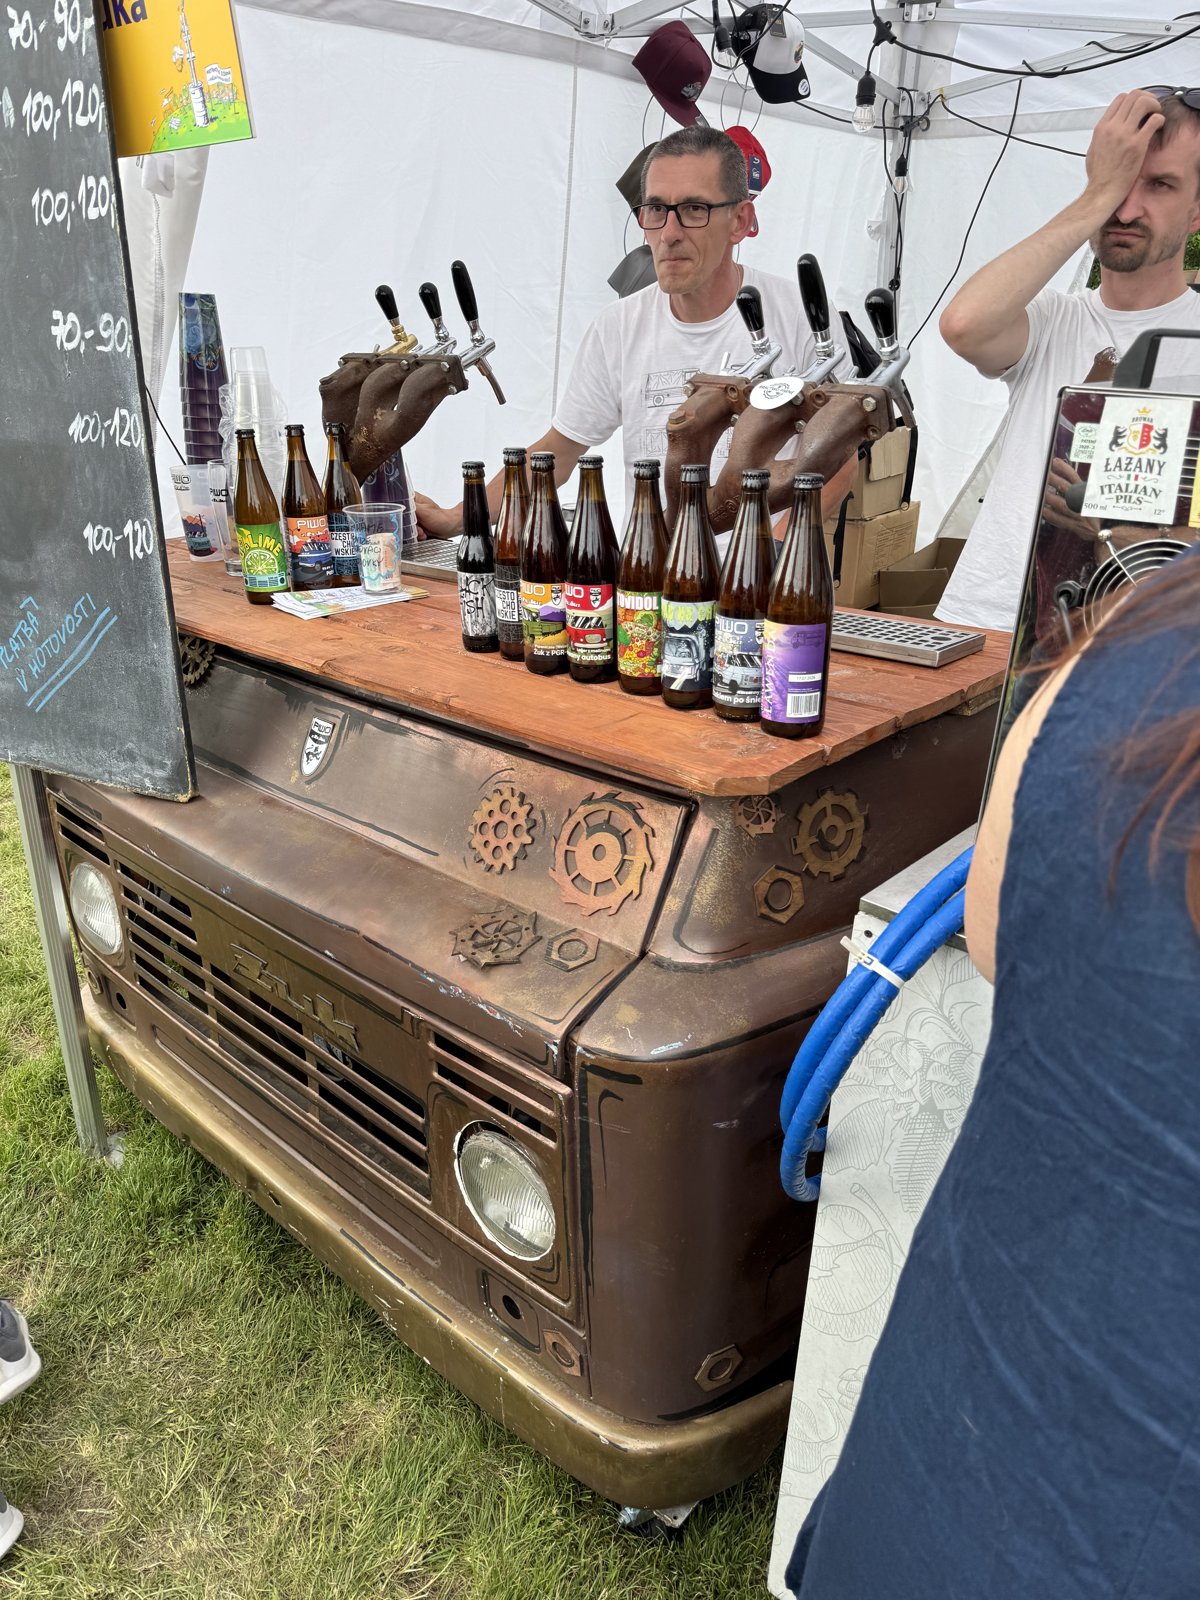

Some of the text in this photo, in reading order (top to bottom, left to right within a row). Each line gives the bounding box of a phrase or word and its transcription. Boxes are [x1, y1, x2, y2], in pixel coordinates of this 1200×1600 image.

[1100, 482, 1163, 499] ITALIAN
[1115, 494, 1144, 506] PILS
[247, 533, 283, 557] LIME
